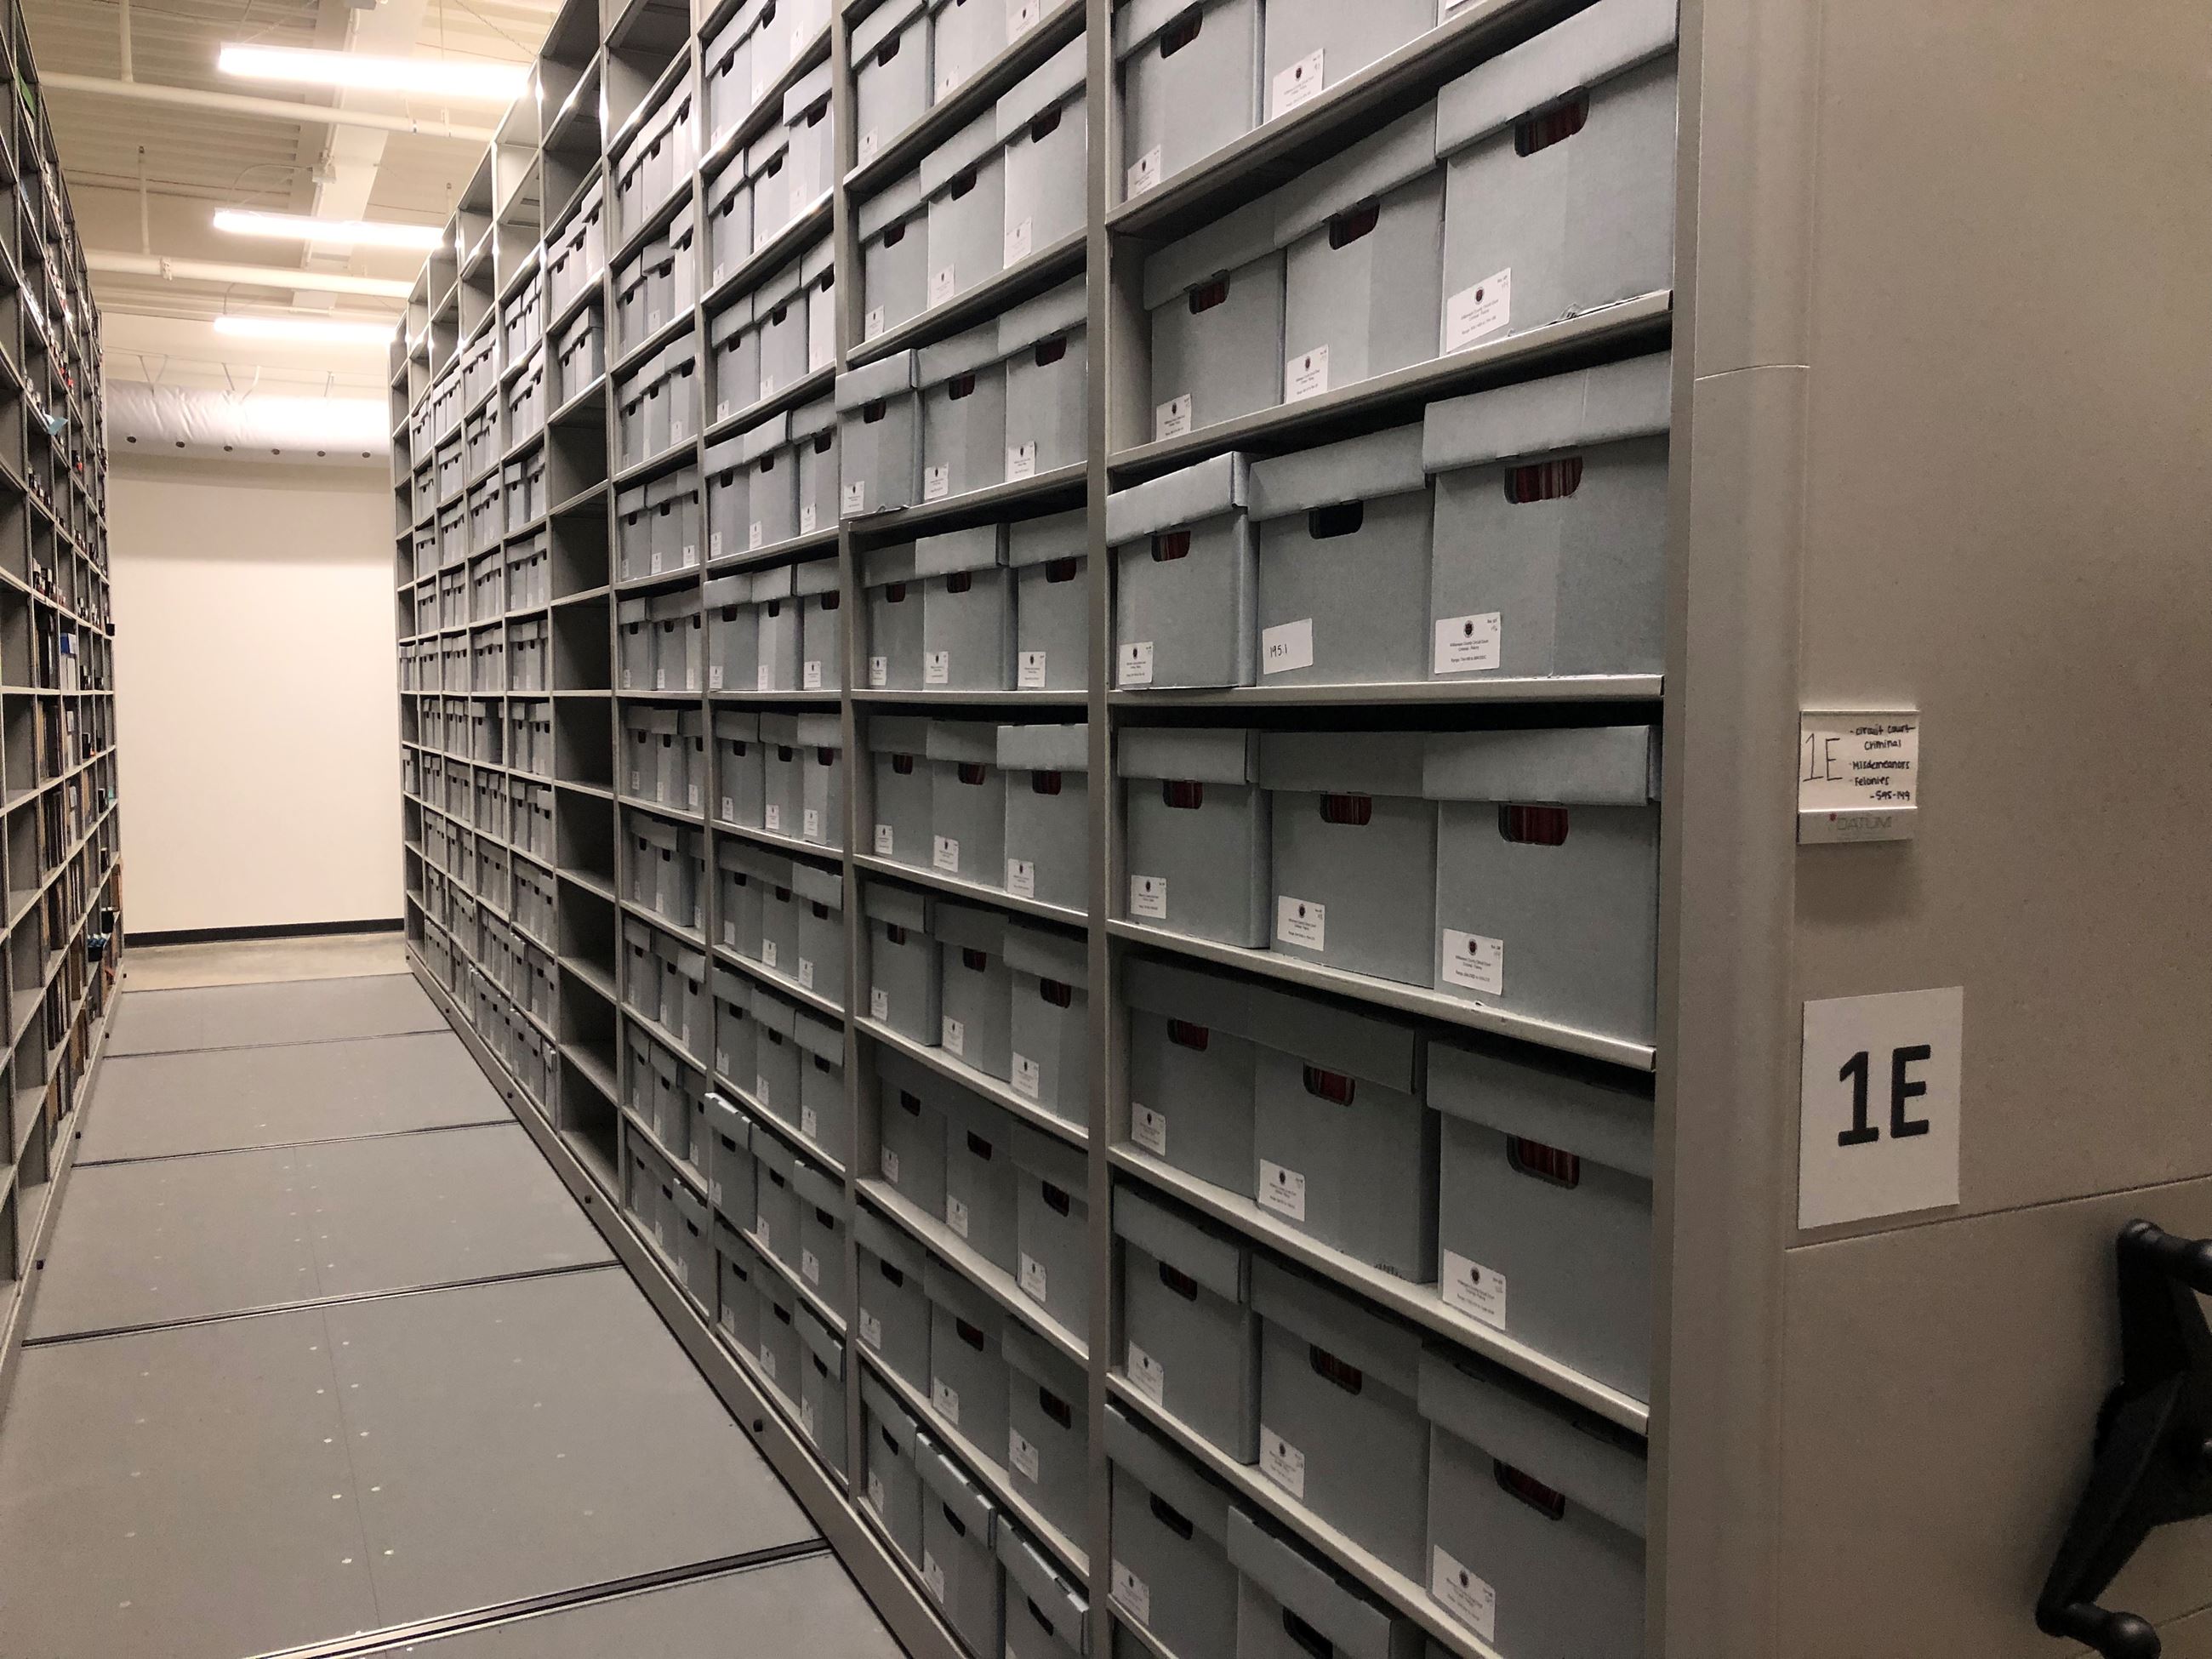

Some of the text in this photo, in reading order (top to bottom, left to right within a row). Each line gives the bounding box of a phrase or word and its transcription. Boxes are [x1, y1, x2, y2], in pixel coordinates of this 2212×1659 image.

[1269, 643, 1287, 658] 1951
[1802, 733, 1844, 782] 1E
[1838, 1044, 1931, 1147] 1E
